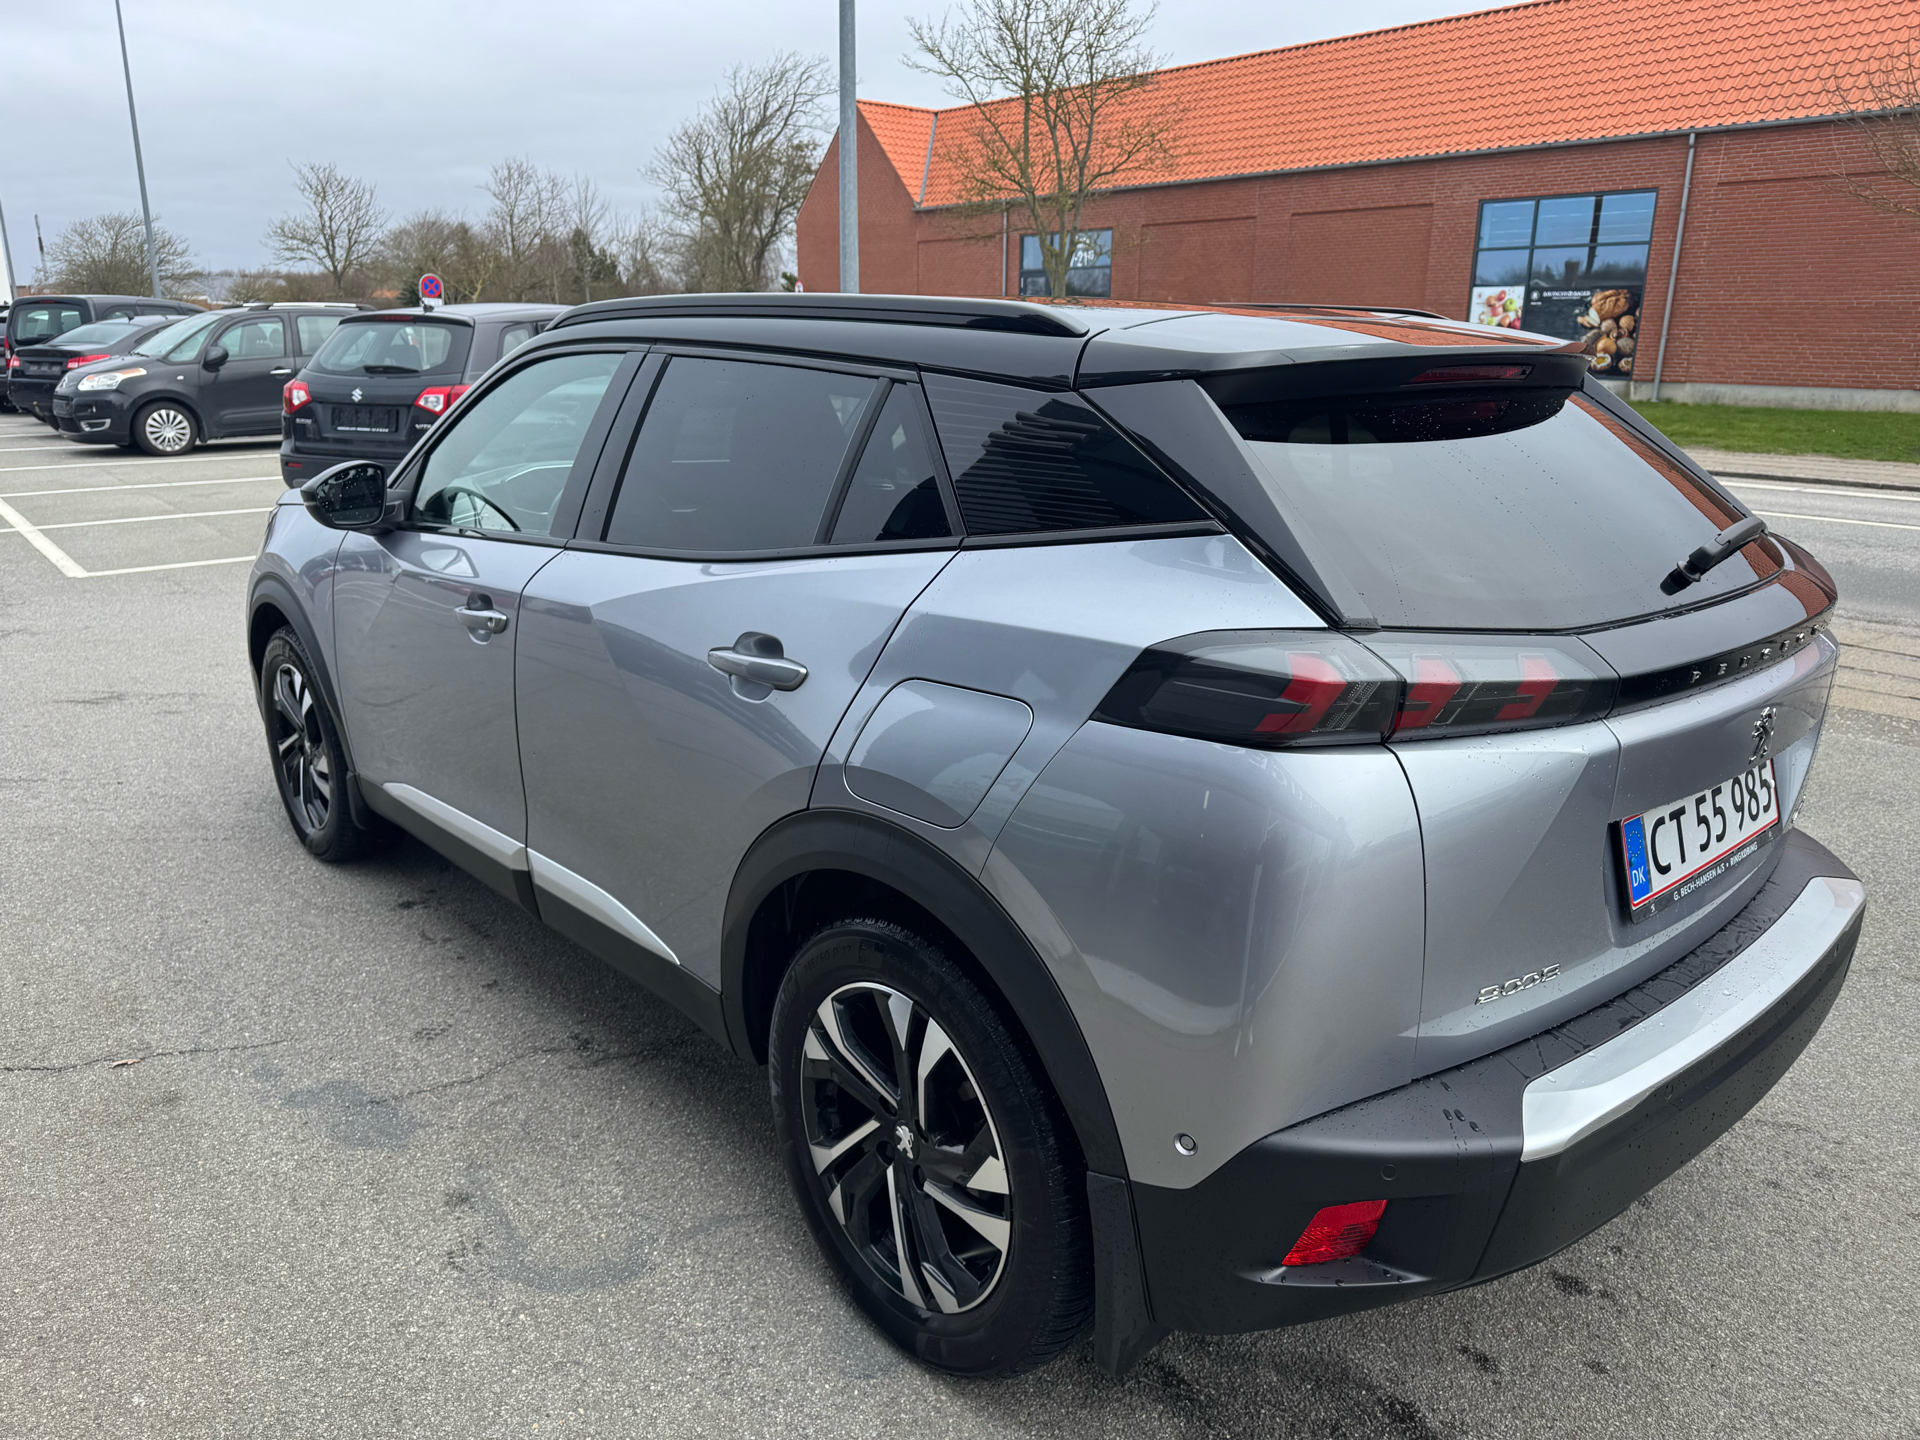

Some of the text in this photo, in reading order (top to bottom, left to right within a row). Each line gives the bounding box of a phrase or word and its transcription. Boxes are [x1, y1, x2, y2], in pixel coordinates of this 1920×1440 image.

[1650, 804, 1687, 875] CT
[1695, 785, 1727, 852] 55
[1731, 761, 1772, 832] 985
[1632, 865, 1646, 887] DK
[1673, 890, 1681, 900] G.
[1680, 868, 1716, 897] BECH-HANSEN
[1474, 963, 1561, 1006] 2008
